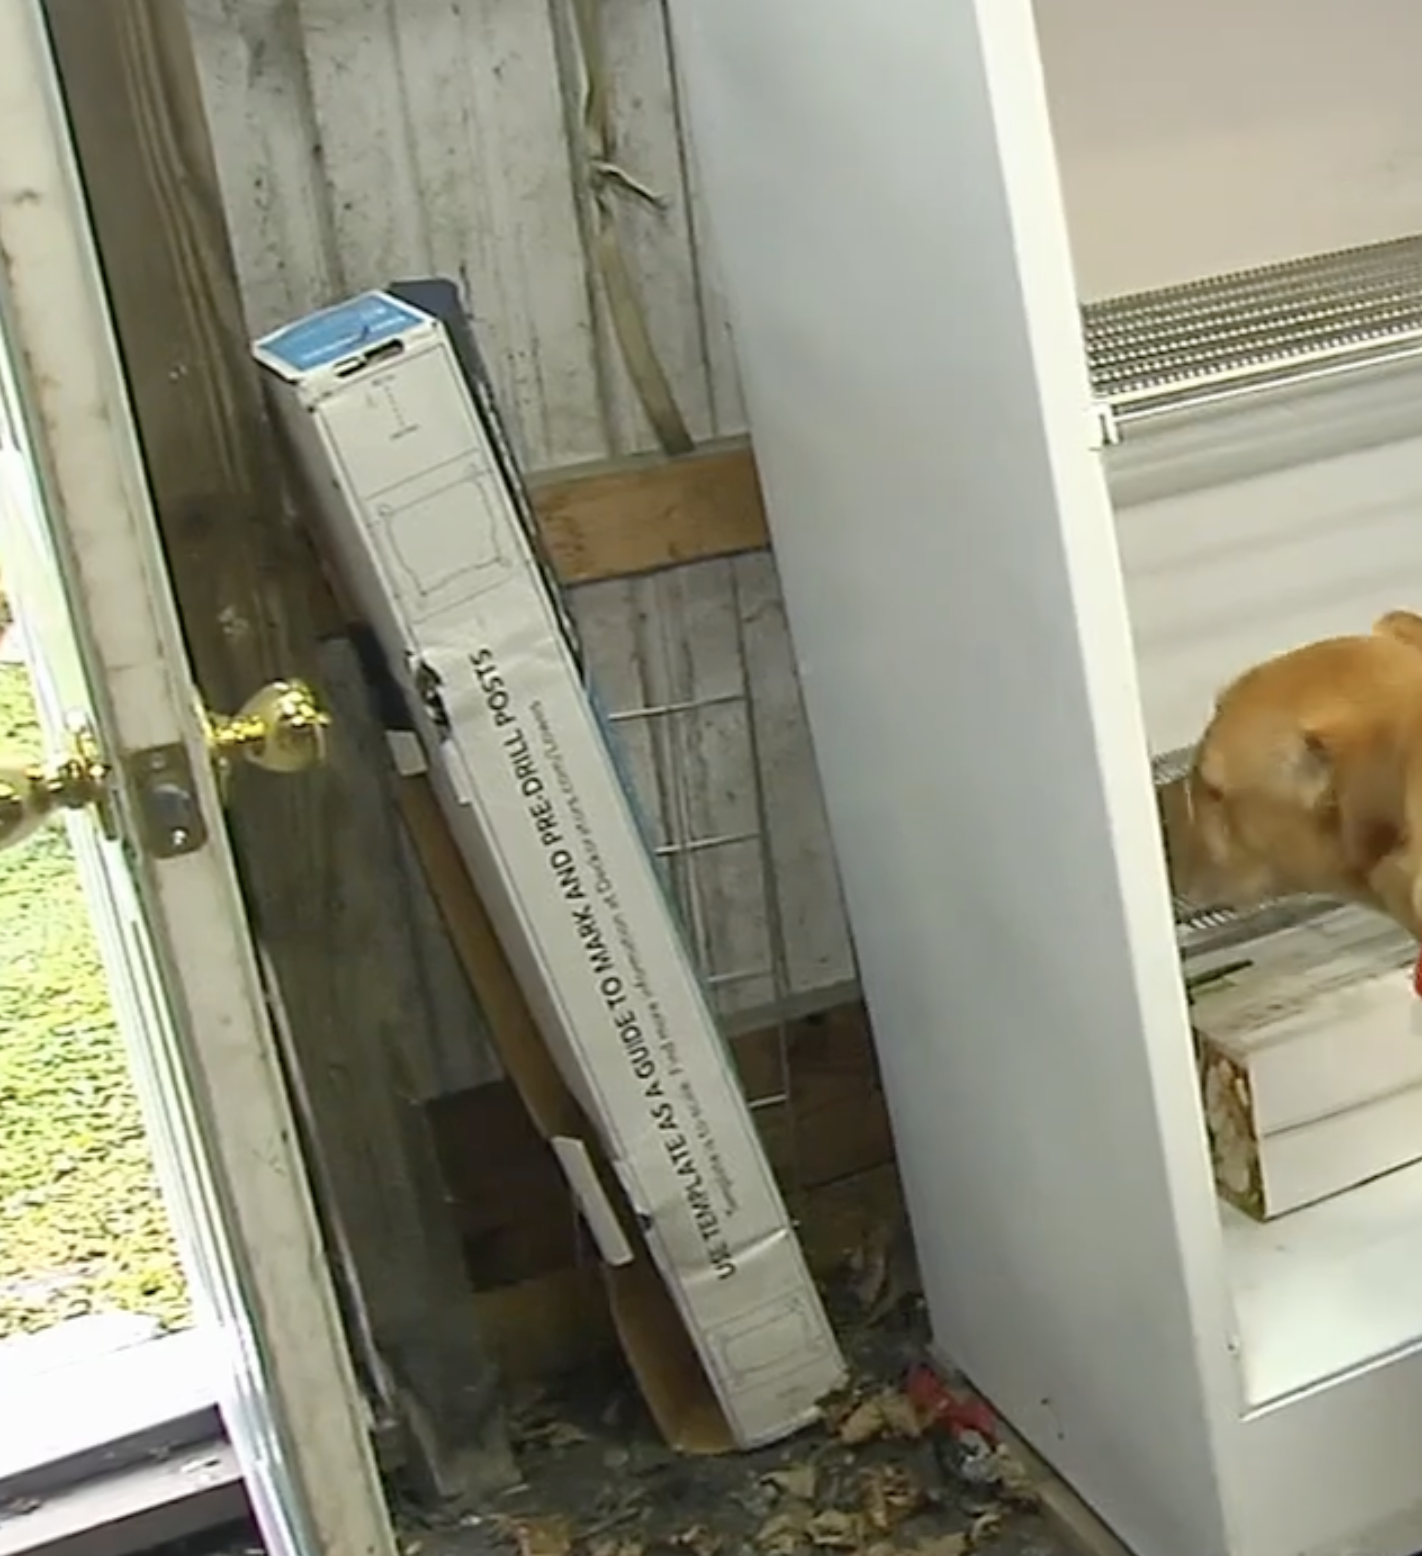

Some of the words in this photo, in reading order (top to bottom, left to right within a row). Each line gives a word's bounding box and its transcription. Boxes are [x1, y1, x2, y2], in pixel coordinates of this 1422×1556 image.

[469, 648, 515, 726] POSTS
[504, 728, 562, 845] PRE-DRILL
[550, 849, 585, 898] AND
[571, 904, 612, 973] MARK
[600, 976, 625, 1010] TO
[614, 1010, 654, 1078] GUIDE
[645, 1080, 663, 1096] A
[650, 1103, 677, 1129] AS
[664, 1134, 718, 1240] TEMPLATE
[708, 1242, 735, 1280] USE
